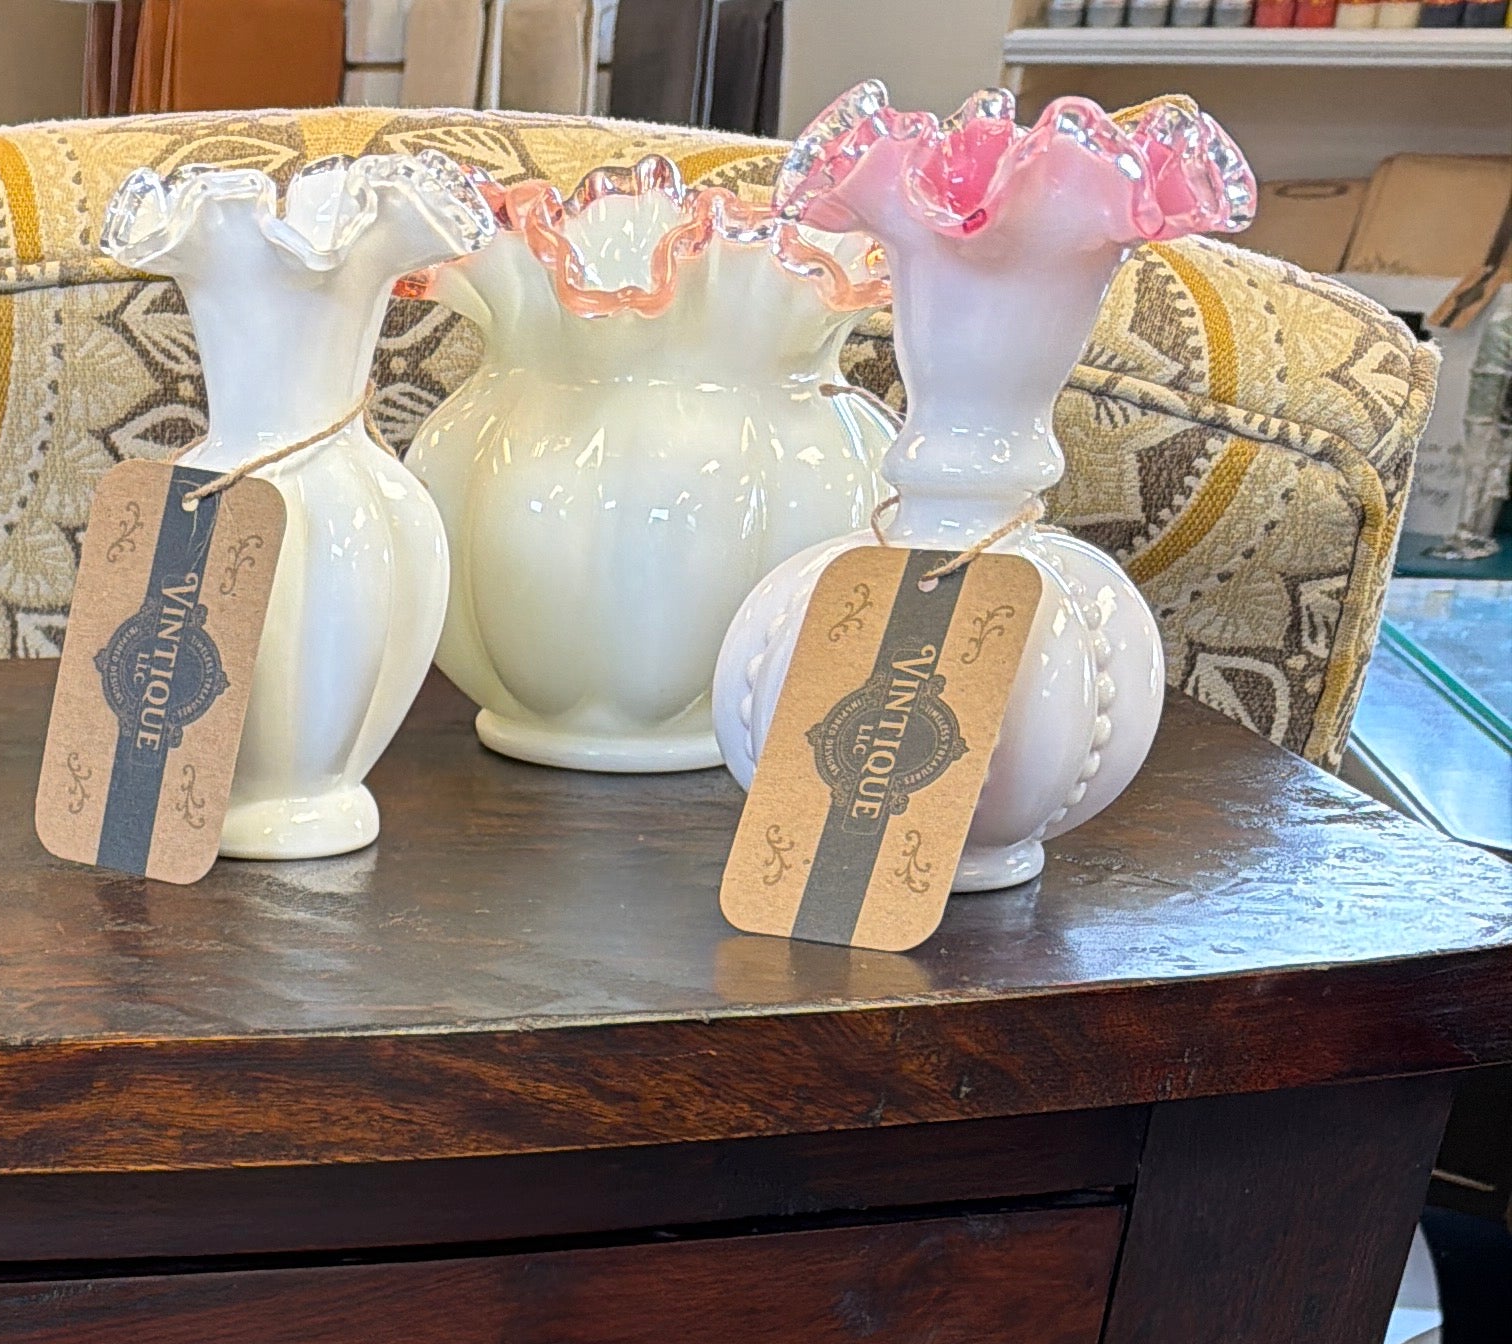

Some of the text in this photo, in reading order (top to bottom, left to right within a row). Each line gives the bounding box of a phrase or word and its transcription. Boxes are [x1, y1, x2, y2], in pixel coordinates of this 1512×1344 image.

[133, 652, 149, 684] LLC
[135, 573, 198, 751] VINTIQUE
[825, 698, 862, 775] INSPIRED DESIGNS
[850, 644, 936, 820] VINTIQUE
[851, 723, 872, 756] LLC
[903, 705, 947, 784] TIMELESS TREASURES
